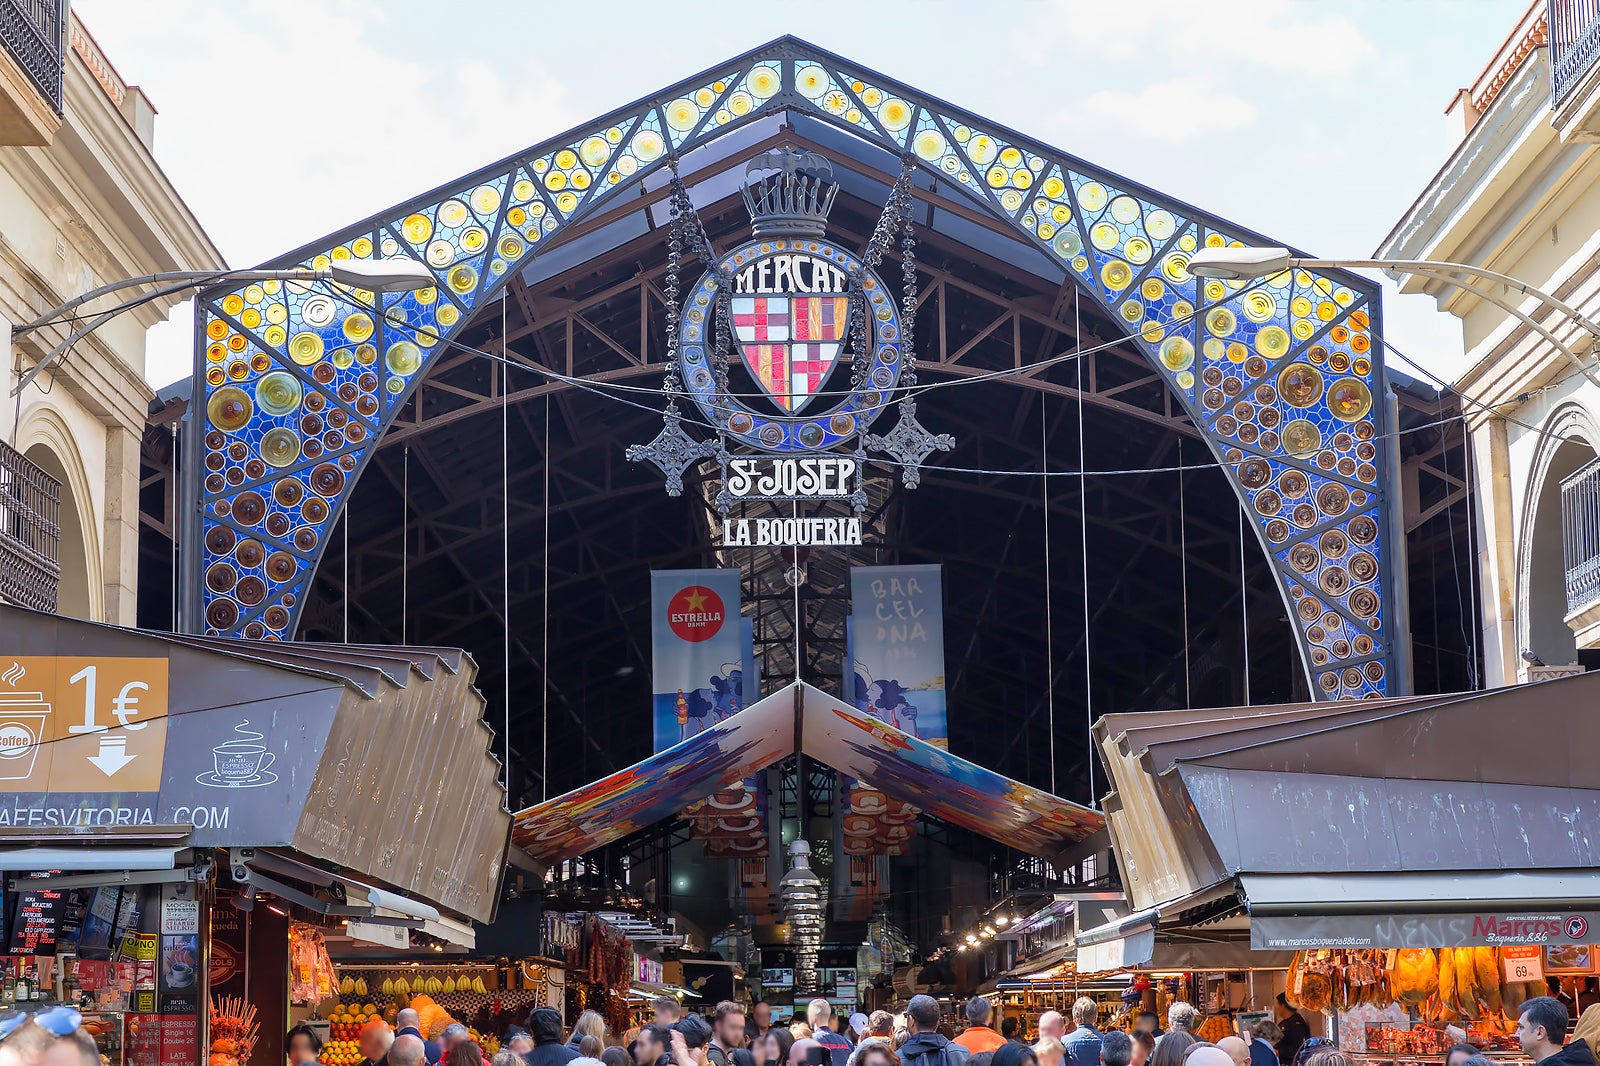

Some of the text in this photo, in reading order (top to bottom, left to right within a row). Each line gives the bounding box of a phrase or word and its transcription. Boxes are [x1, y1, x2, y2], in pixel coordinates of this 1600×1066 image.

[735, 255, 847, 293] MERCAT
[757, 458, 856, 496] JOSEP
[723, 517, 863, 546] LA BOQUERIA
[671, 612, 721, 623] ESTRELLA
[68, 665, 149, 734] 1€
[0, 735, 28, 747] offee
[1472, 915, 1561, 937] Marcos
[140, 940, 155, 948] NO
[1515, 965, 1527, 978] 69
